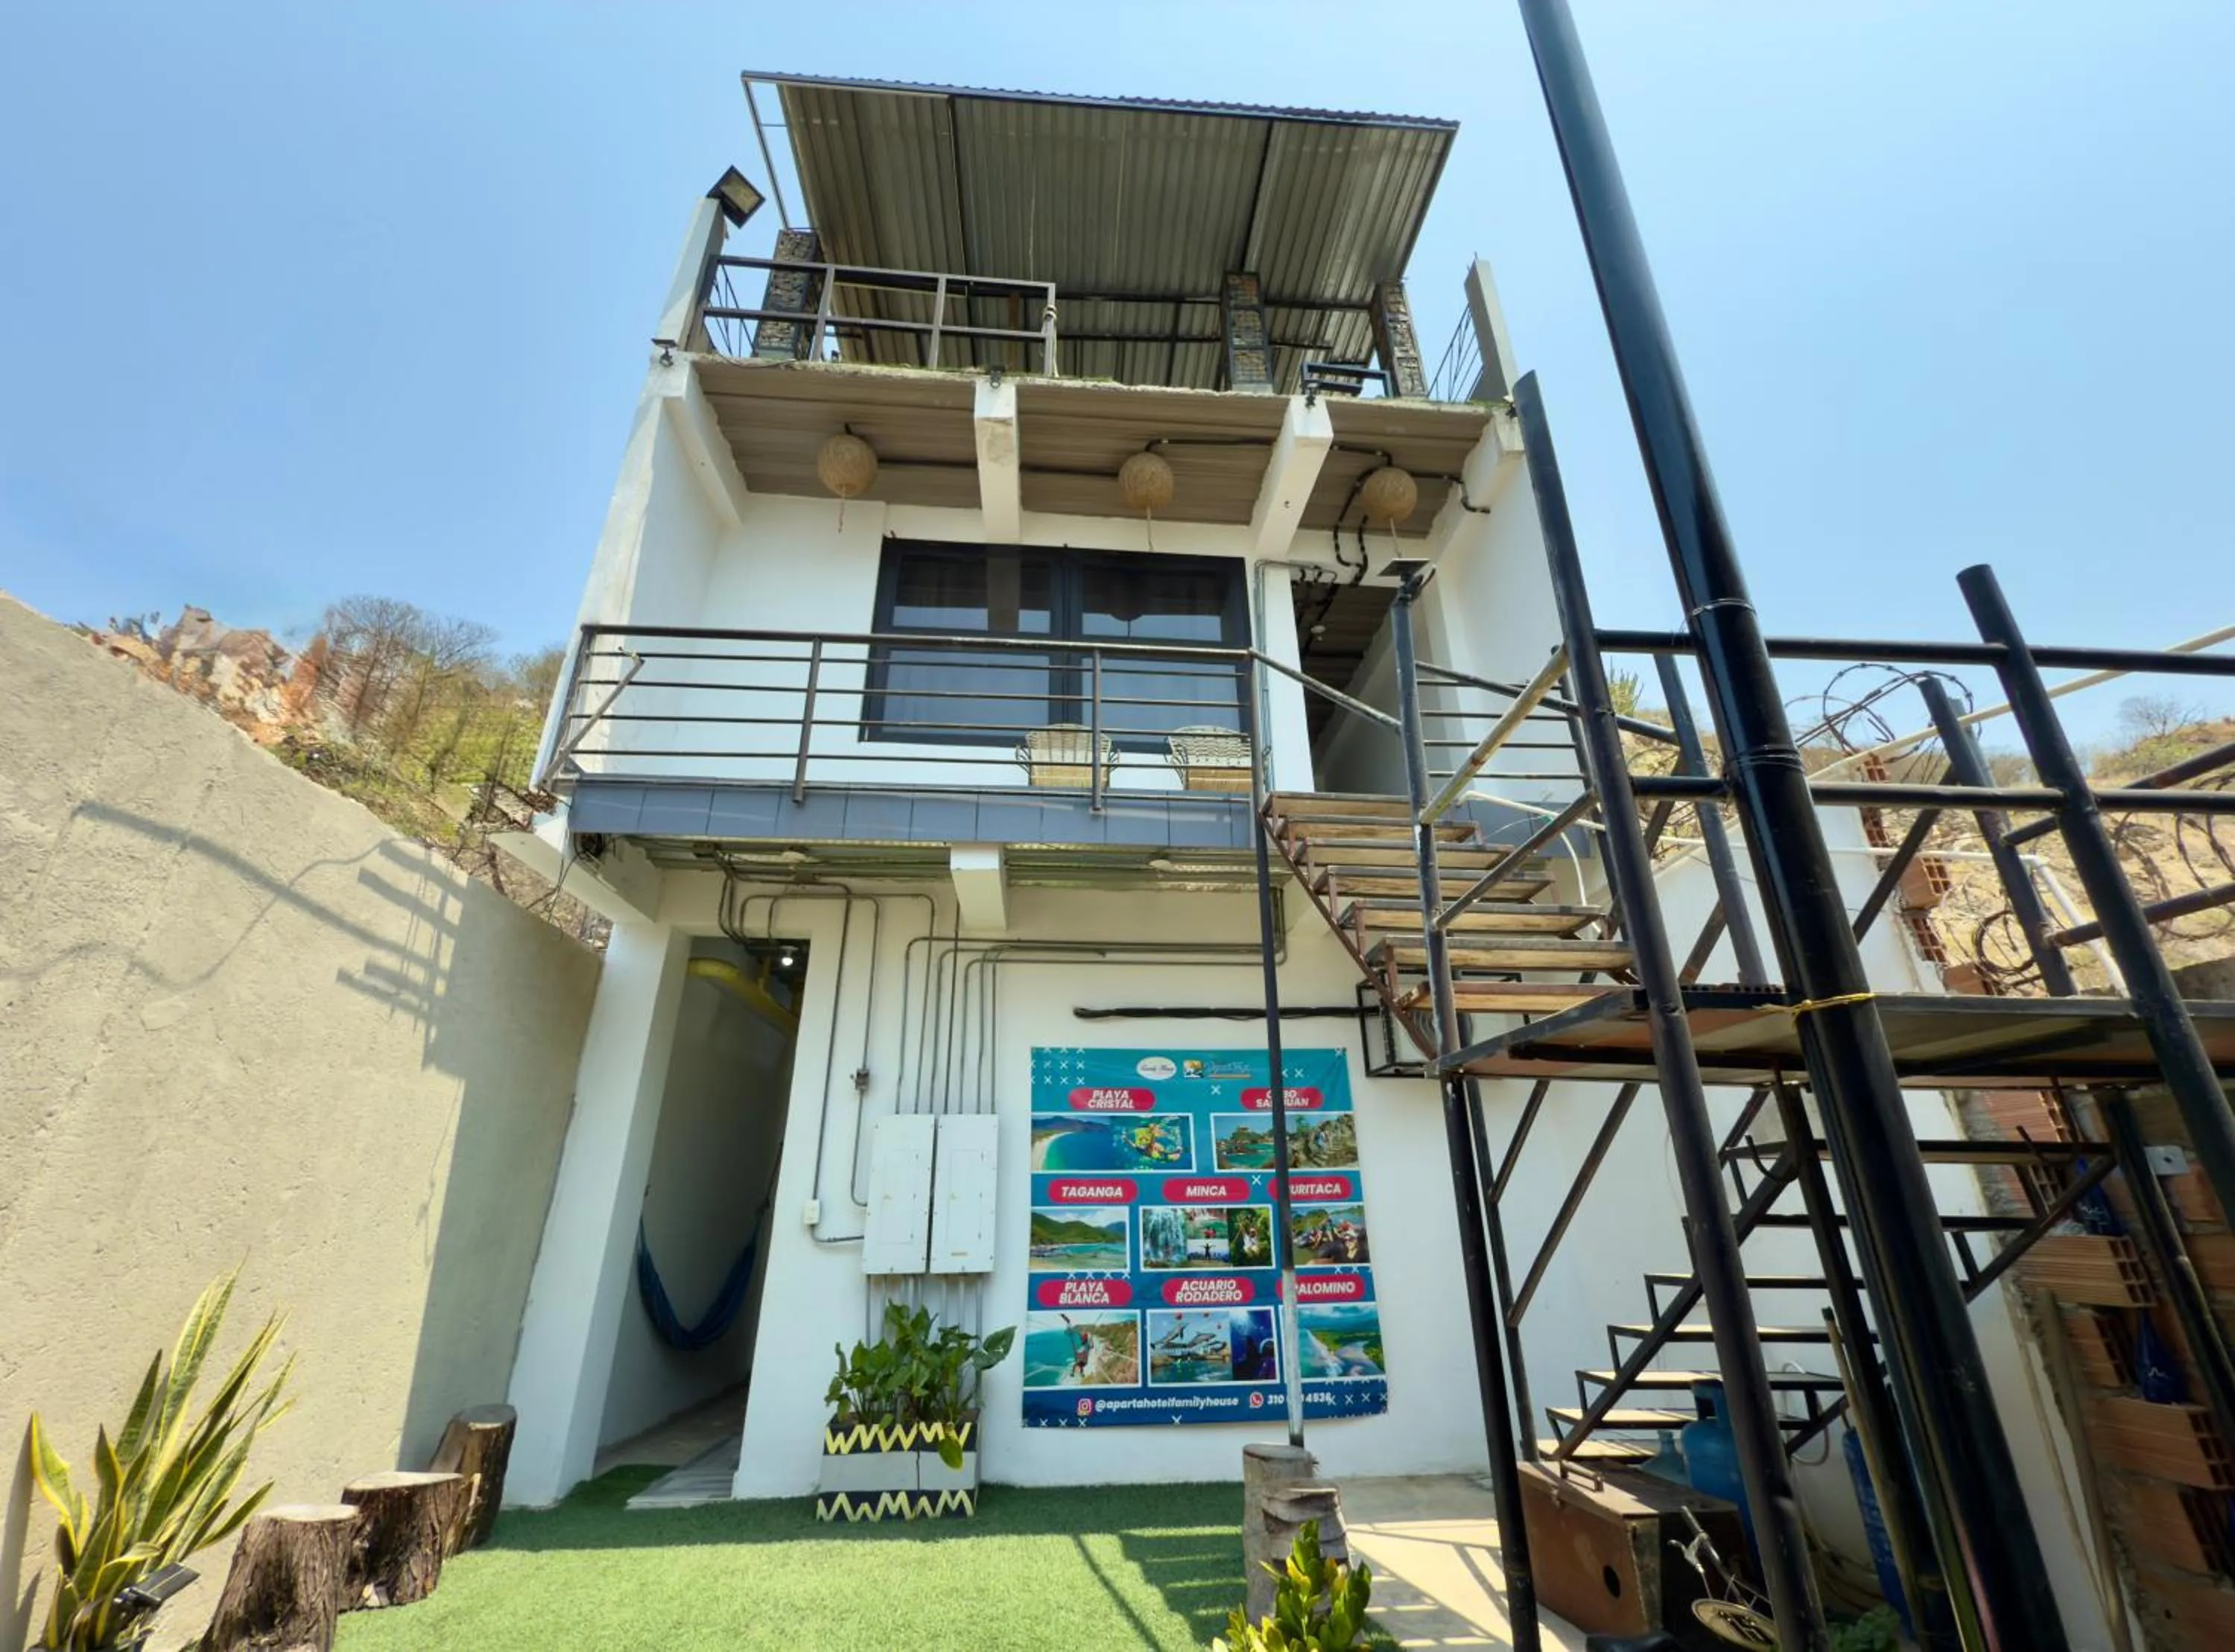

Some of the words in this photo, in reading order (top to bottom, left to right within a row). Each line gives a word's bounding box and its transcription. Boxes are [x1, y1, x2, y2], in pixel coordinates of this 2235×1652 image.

[1092, 1090, 1129, 1099] PLAYA
[1088, 1099, 1135, 1108] CRISTAL
[1061, 1186, 1123, 1198] TAGANGA
[1185, 1184, 1228, 1197] MINCA
[1288, 1184, 1342, 1195] URITACA
[1065, 1282, 1104, 1292] PLAYA
[1181, 1280, 1237, 1291] ACUARIO
[1059, 1292, 1109, 1304] BLANCA
[1176, 1290, 1243, 1303] RODADERO
[1094, 1395, 1240, 1412] @apartahotelfamilyhouse
[1267, 1394, 1284, 1405] 310
